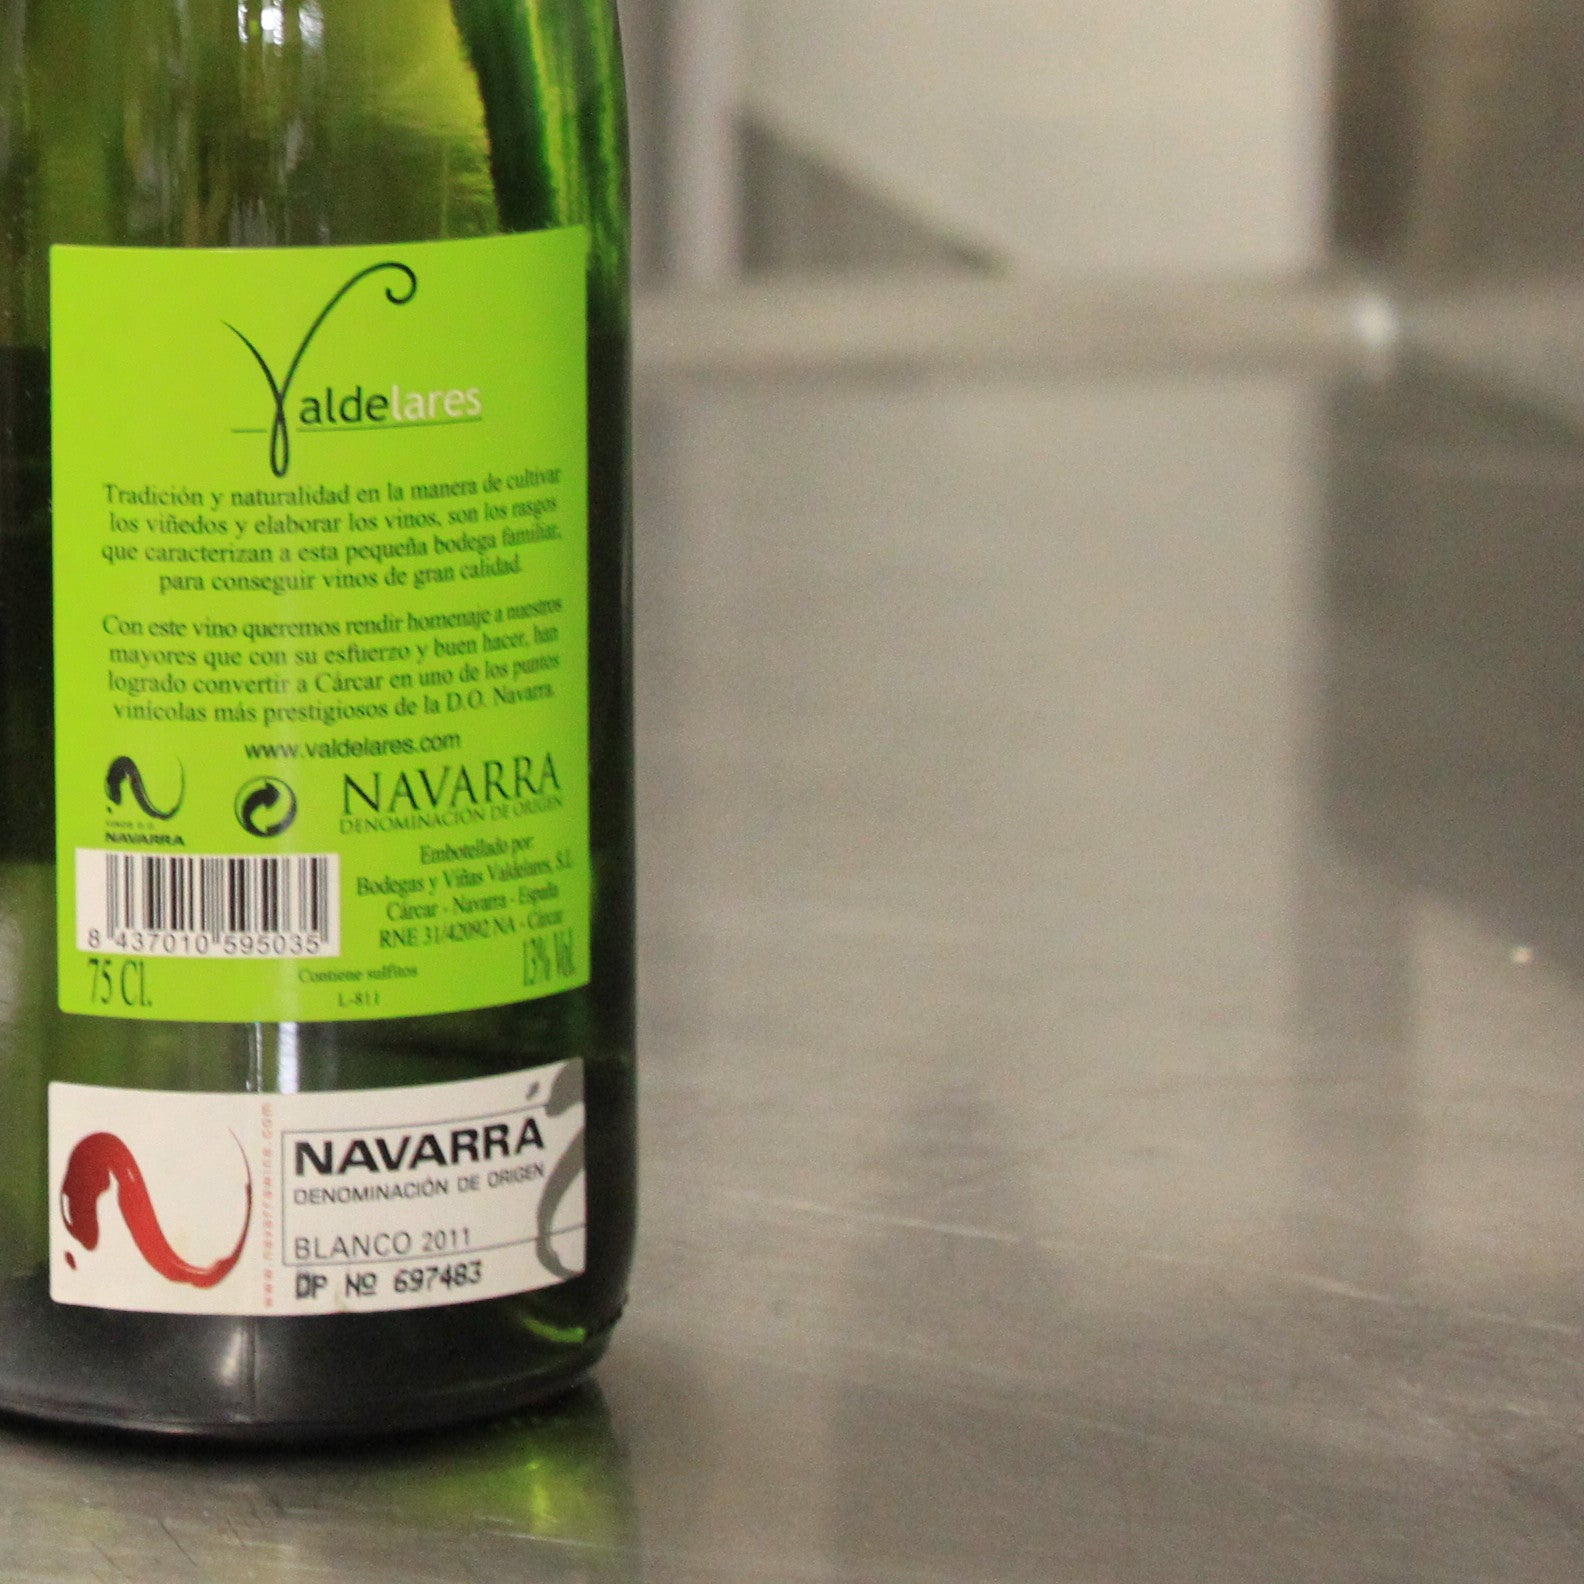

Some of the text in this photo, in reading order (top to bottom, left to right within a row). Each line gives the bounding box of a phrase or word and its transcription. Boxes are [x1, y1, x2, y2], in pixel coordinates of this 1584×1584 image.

[103, 468, 561, 511] Tradición y naturalidad en la manera de cultivar
[110, 497, 557, 539] los viñedos y elaborar los vinos, son los rasgos
[102, 545, 137, 565] que
[145, 543, 273, 562] caracterizan
[279, 548, 290, 562] a
[298, 544, 337, 561] esta
[346, 536, 427, 565] pequeña
[434, 531, 496, 556] bodega
[159, 575, 204, 595] para
[211, 571, 315, 595] conseguir
[322, 570, 378, 589] vinos
[384, 566, 407, 586] de
[413, 566, 455, 590] gran
[103, 598, 562, 643] Con este vino queremos rendir homenaje a nuestros
[109, 648, 196, 668] mayores
[204, 651, 242, 671] que
[249, 651, 286, 666] con
[295, 651, 317, 665] su
[325, 643, 410, 666] esfuerzo
[416, 645, 426, 663] y
[434, 638, 477, 658] buen
[533, 624, 558, 644] han
[108, 655, 560, 696] logrado convertir a Cárcar en uno de los puntos
[113, 699, 206, 721] vinícolas
[214, 701, 256, 722] más
[264, 698, 388, 727] prestigiosos
[395, 696, 417, 716] de
[424, 695, 440, 714] la
[245, 733, 461, 759] www.valdelares.com
[343, 752, 560, 815] NAVARRA
[105, 831, 185, 847] NAVARRA
[421, 837, 533, 866] Embotellado por
[357, 874, 423, 898] Bodegas
[429, 877, 437, 896] y
[454, 894, 507, 914] Navarra
[88, 928, 320, 955] 8 437010 595035
[88, 958, 112, 1006] 75
[295, 1117, 545, 1176] NAVARRA
[294, 1162, 545, 1206] DENOMINACIÓN DE ORIGEN
[294, 1226, 471, 1261] BLANCO 2011
[394, 1260, 482, 1294] 697483
